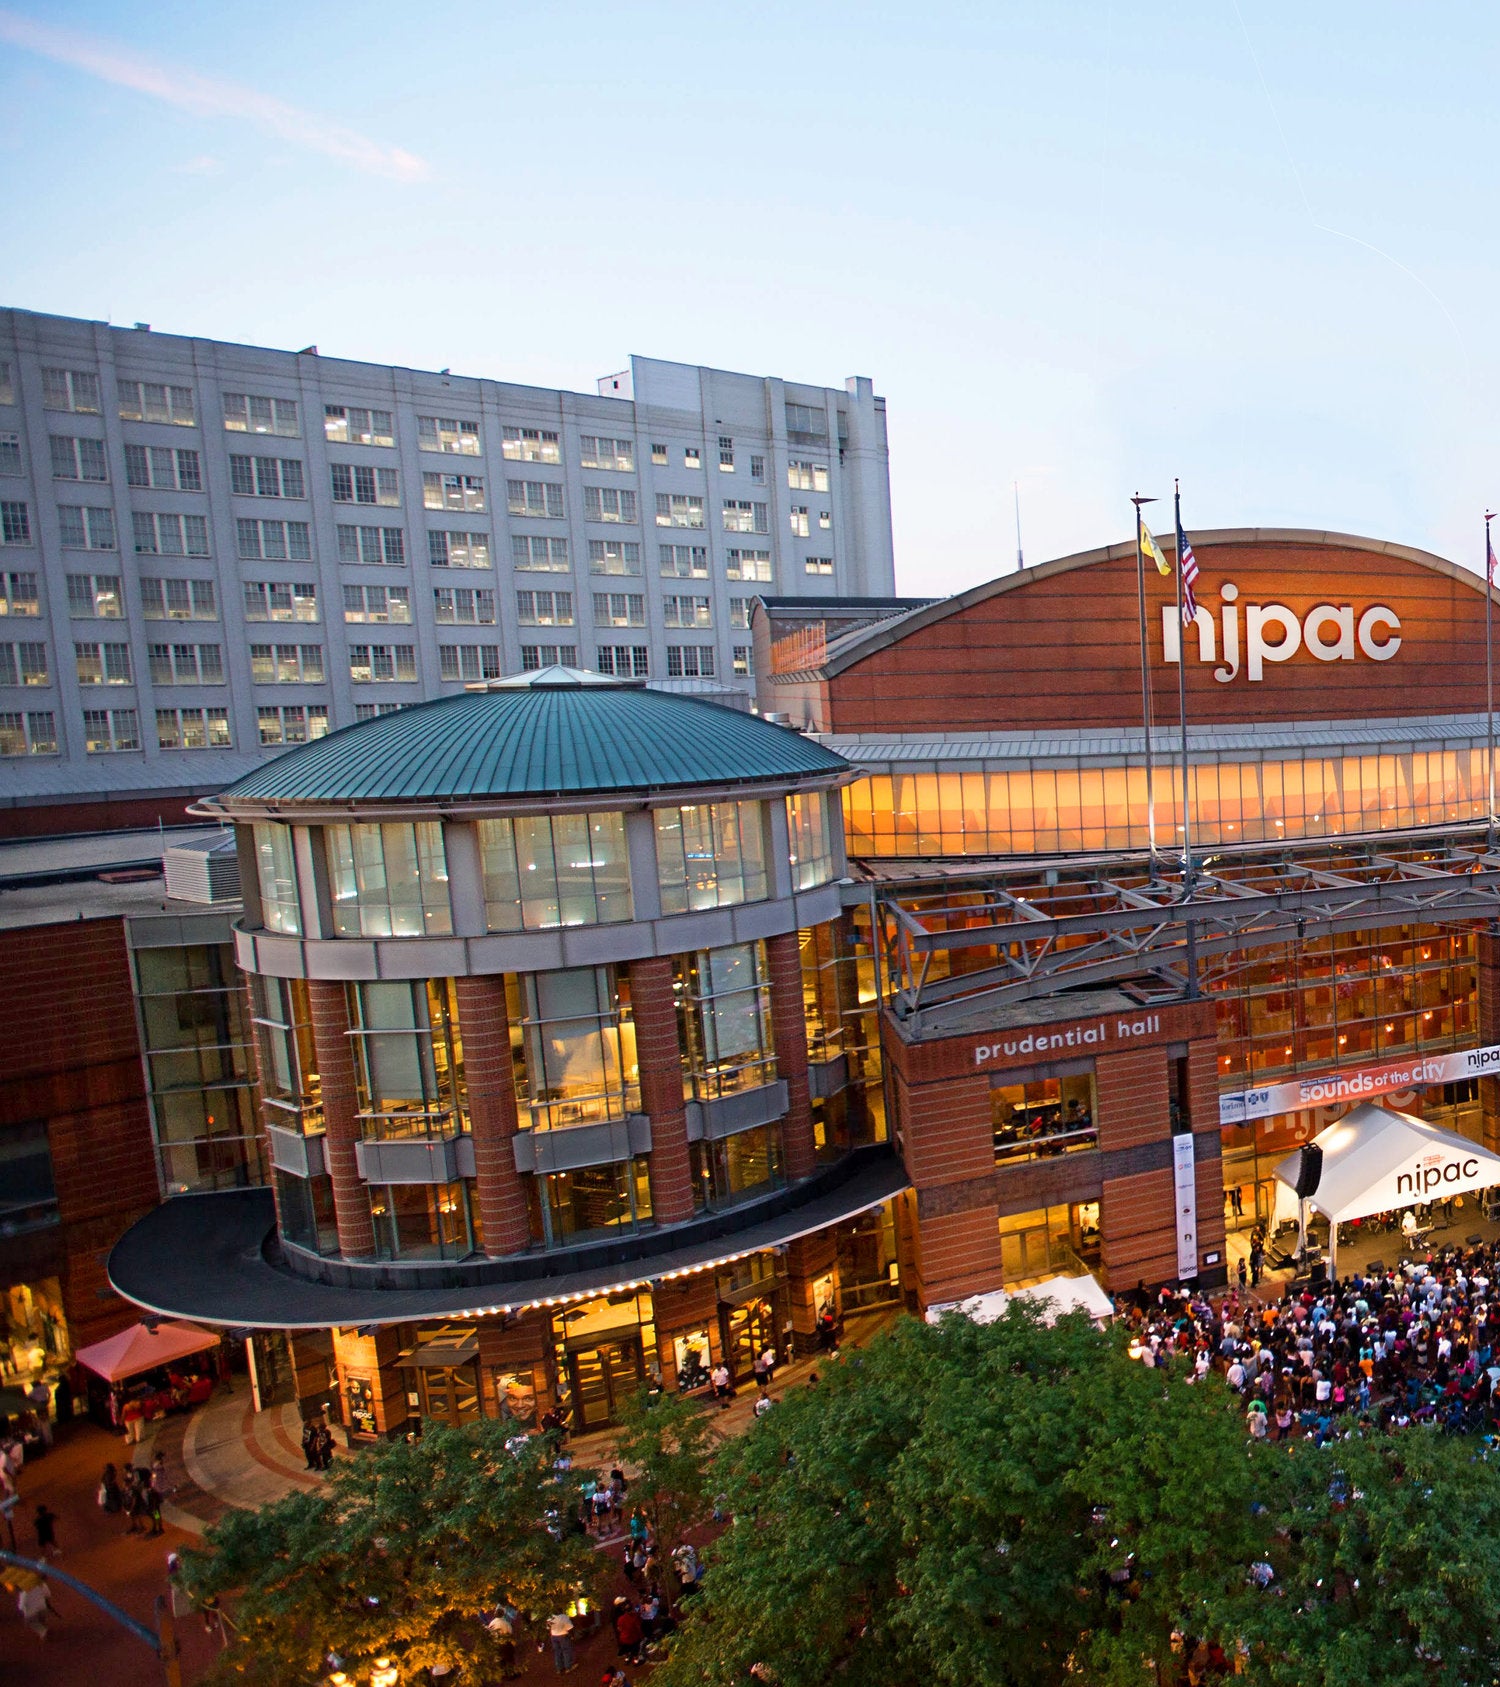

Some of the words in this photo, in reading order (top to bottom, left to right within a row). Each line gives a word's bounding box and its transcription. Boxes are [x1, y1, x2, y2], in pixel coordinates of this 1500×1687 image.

[1162, 583, 1401, 683] njpac
[974, 1024, 1106, 1066] prudential
[1117, 1015, 1160, 1038] hall
[1300, 1073, 1374, 1103] sounds
[1374, 1073, 1389, 1086] of
[1390, 1070, 1409, 1084] the
[1412, 1061, 1445, 1082] city
[1397, 1159, 1479, 1198] njpac
